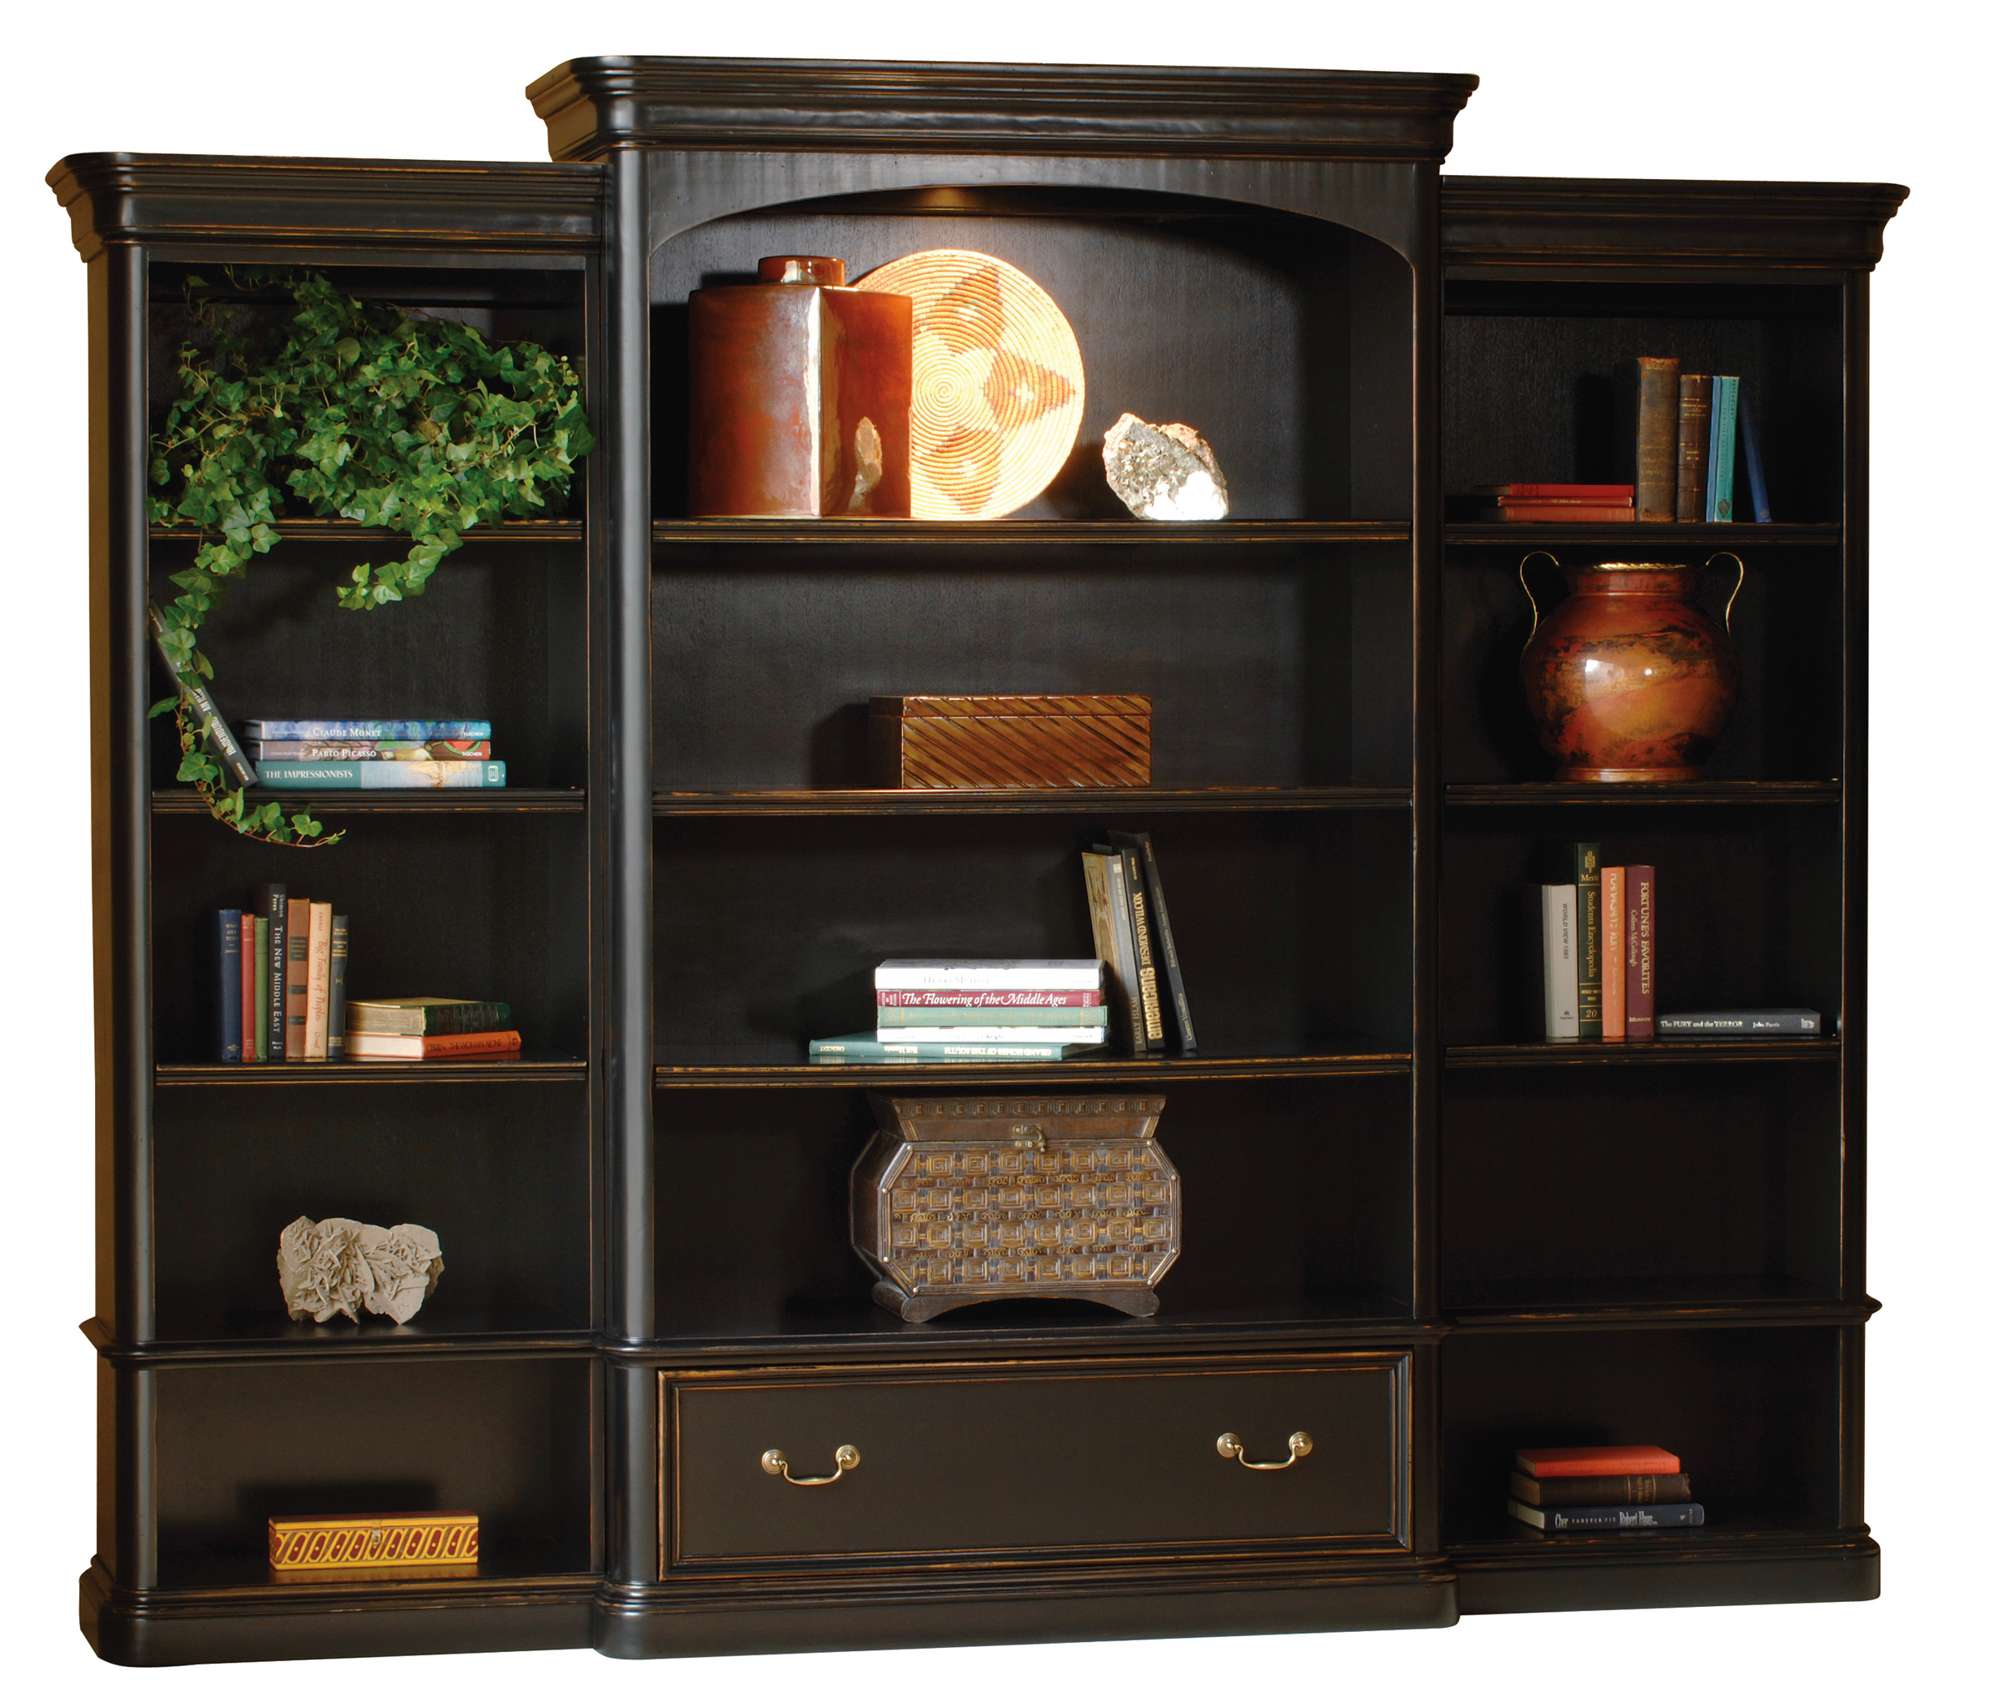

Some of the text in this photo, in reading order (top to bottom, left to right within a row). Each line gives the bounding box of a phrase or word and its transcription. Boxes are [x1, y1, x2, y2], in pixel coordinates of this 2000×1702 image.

[312, 728, 347, 737] CLAUDE
[350, 728, 382, 737] MONET
[342, 749, 377, 758] PICASSO
[266, 770, 353, 779] THE IMPRESSIONISTS
[1134, 892, 1146, 926] WILCOX
[274, 926, 283, 944] THE
[1137, 926, 1152, 966] DESMOND
[274, 948, 282, 969] NEW
[1586, 926, 1597, 978] Encyclopedia
[1642, 940, 1650, 994] FAVORITES
[273, 972, 282, 1007] MIDDLE
[902, 993, 920, 1005] The
[922, 993, 972, 1007] Flowering
[974, 993, 985, 1008] of
[986, 993, 1000, 1005] the
[1001, 993, 1045, 1005] Middle
[1046, 994, 1067, 1007] Ages
[272, 1009, 282, 1033] EAST
